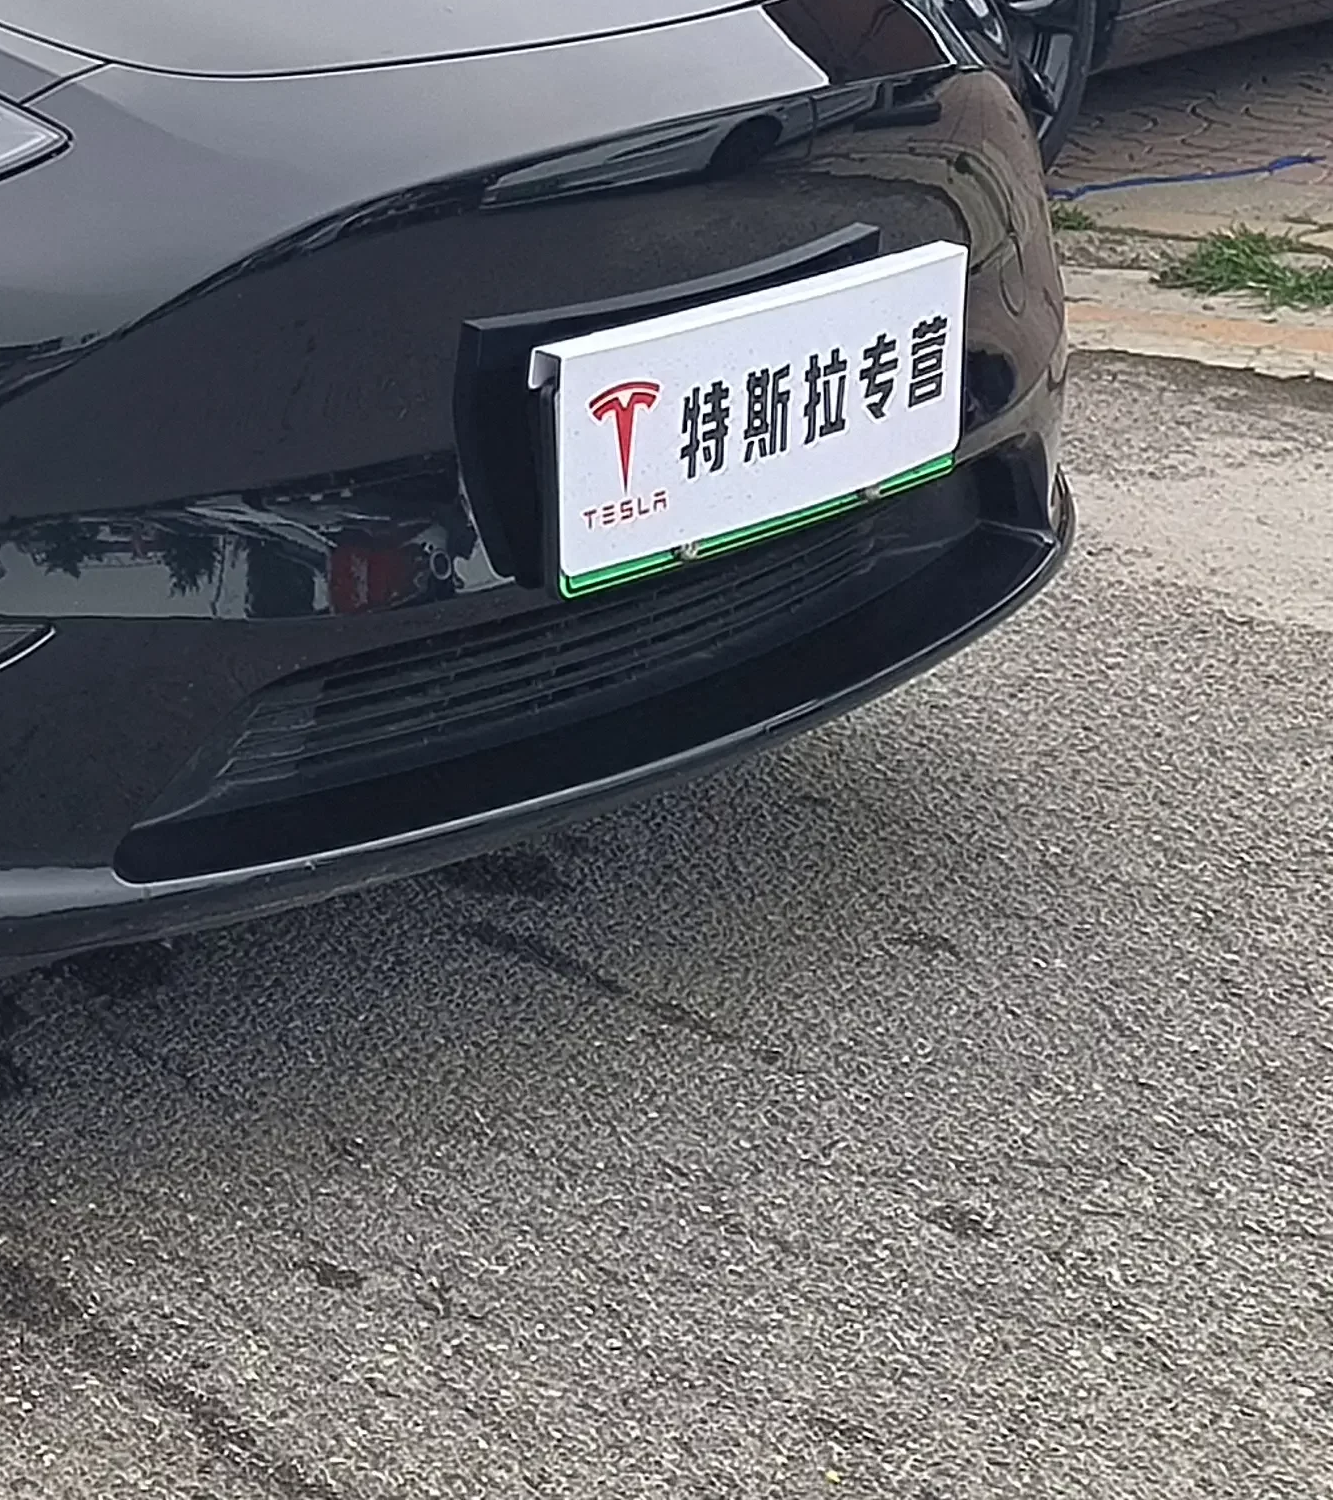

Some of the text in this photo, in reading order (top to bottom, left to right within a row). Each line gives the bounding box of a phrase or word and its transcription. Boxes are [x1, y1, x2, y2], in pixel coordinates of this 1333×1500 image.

[679, 315, 949, 480] 特斯拉专营
[583, 490, 669, 531] TESLA
